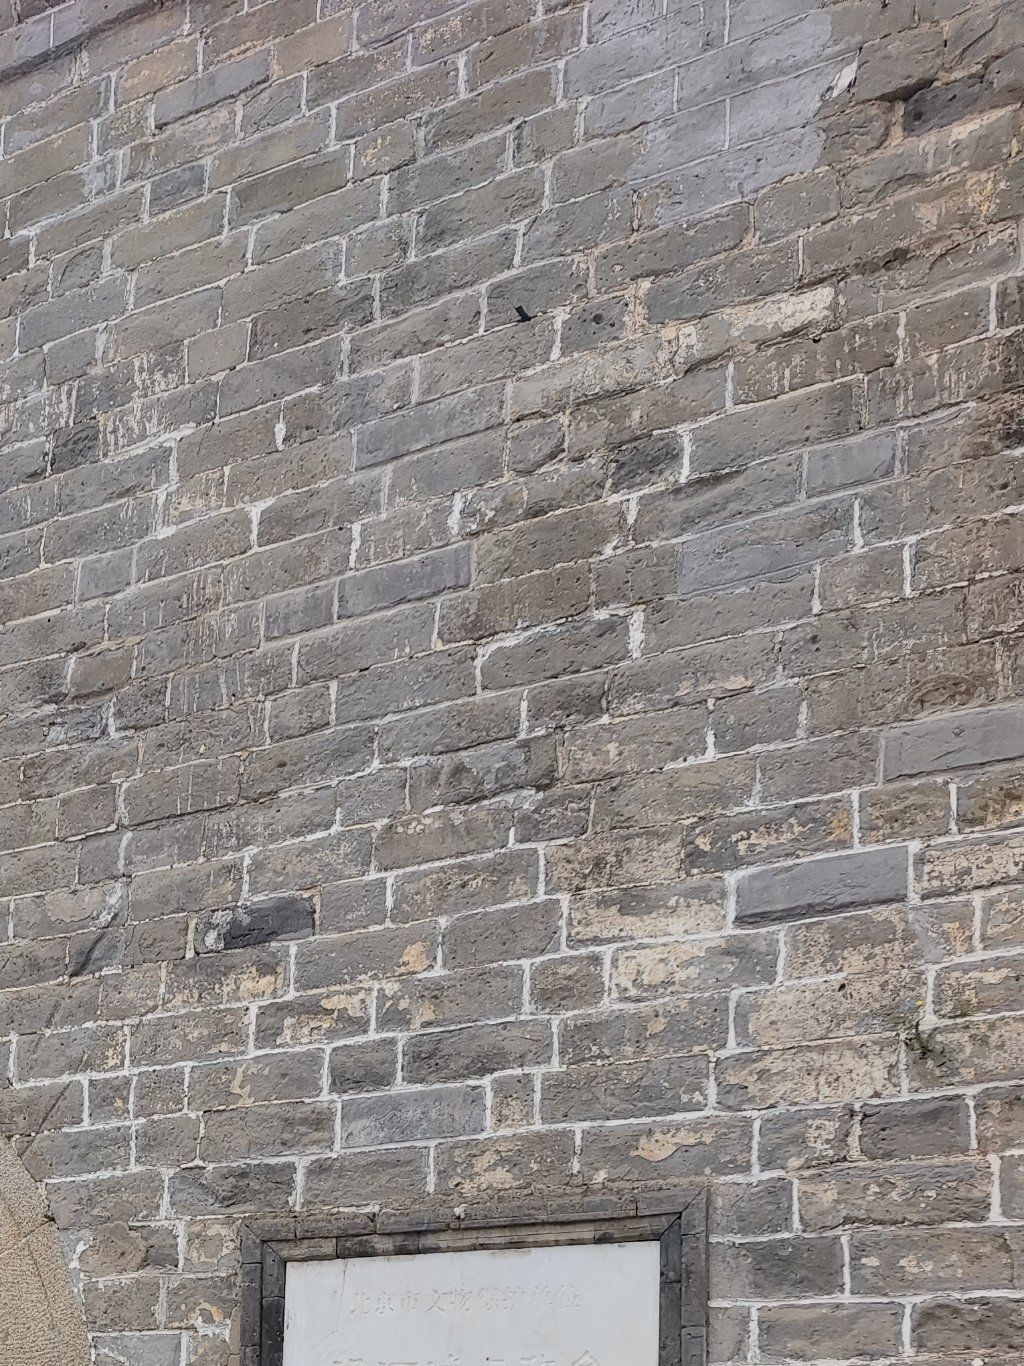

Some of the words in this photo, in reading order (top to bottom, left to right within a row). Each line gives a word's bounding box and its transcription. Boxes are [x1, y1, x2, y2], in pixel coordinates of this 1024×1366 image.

[349, 1283, 582, 1316] 北京市文物保护单位
